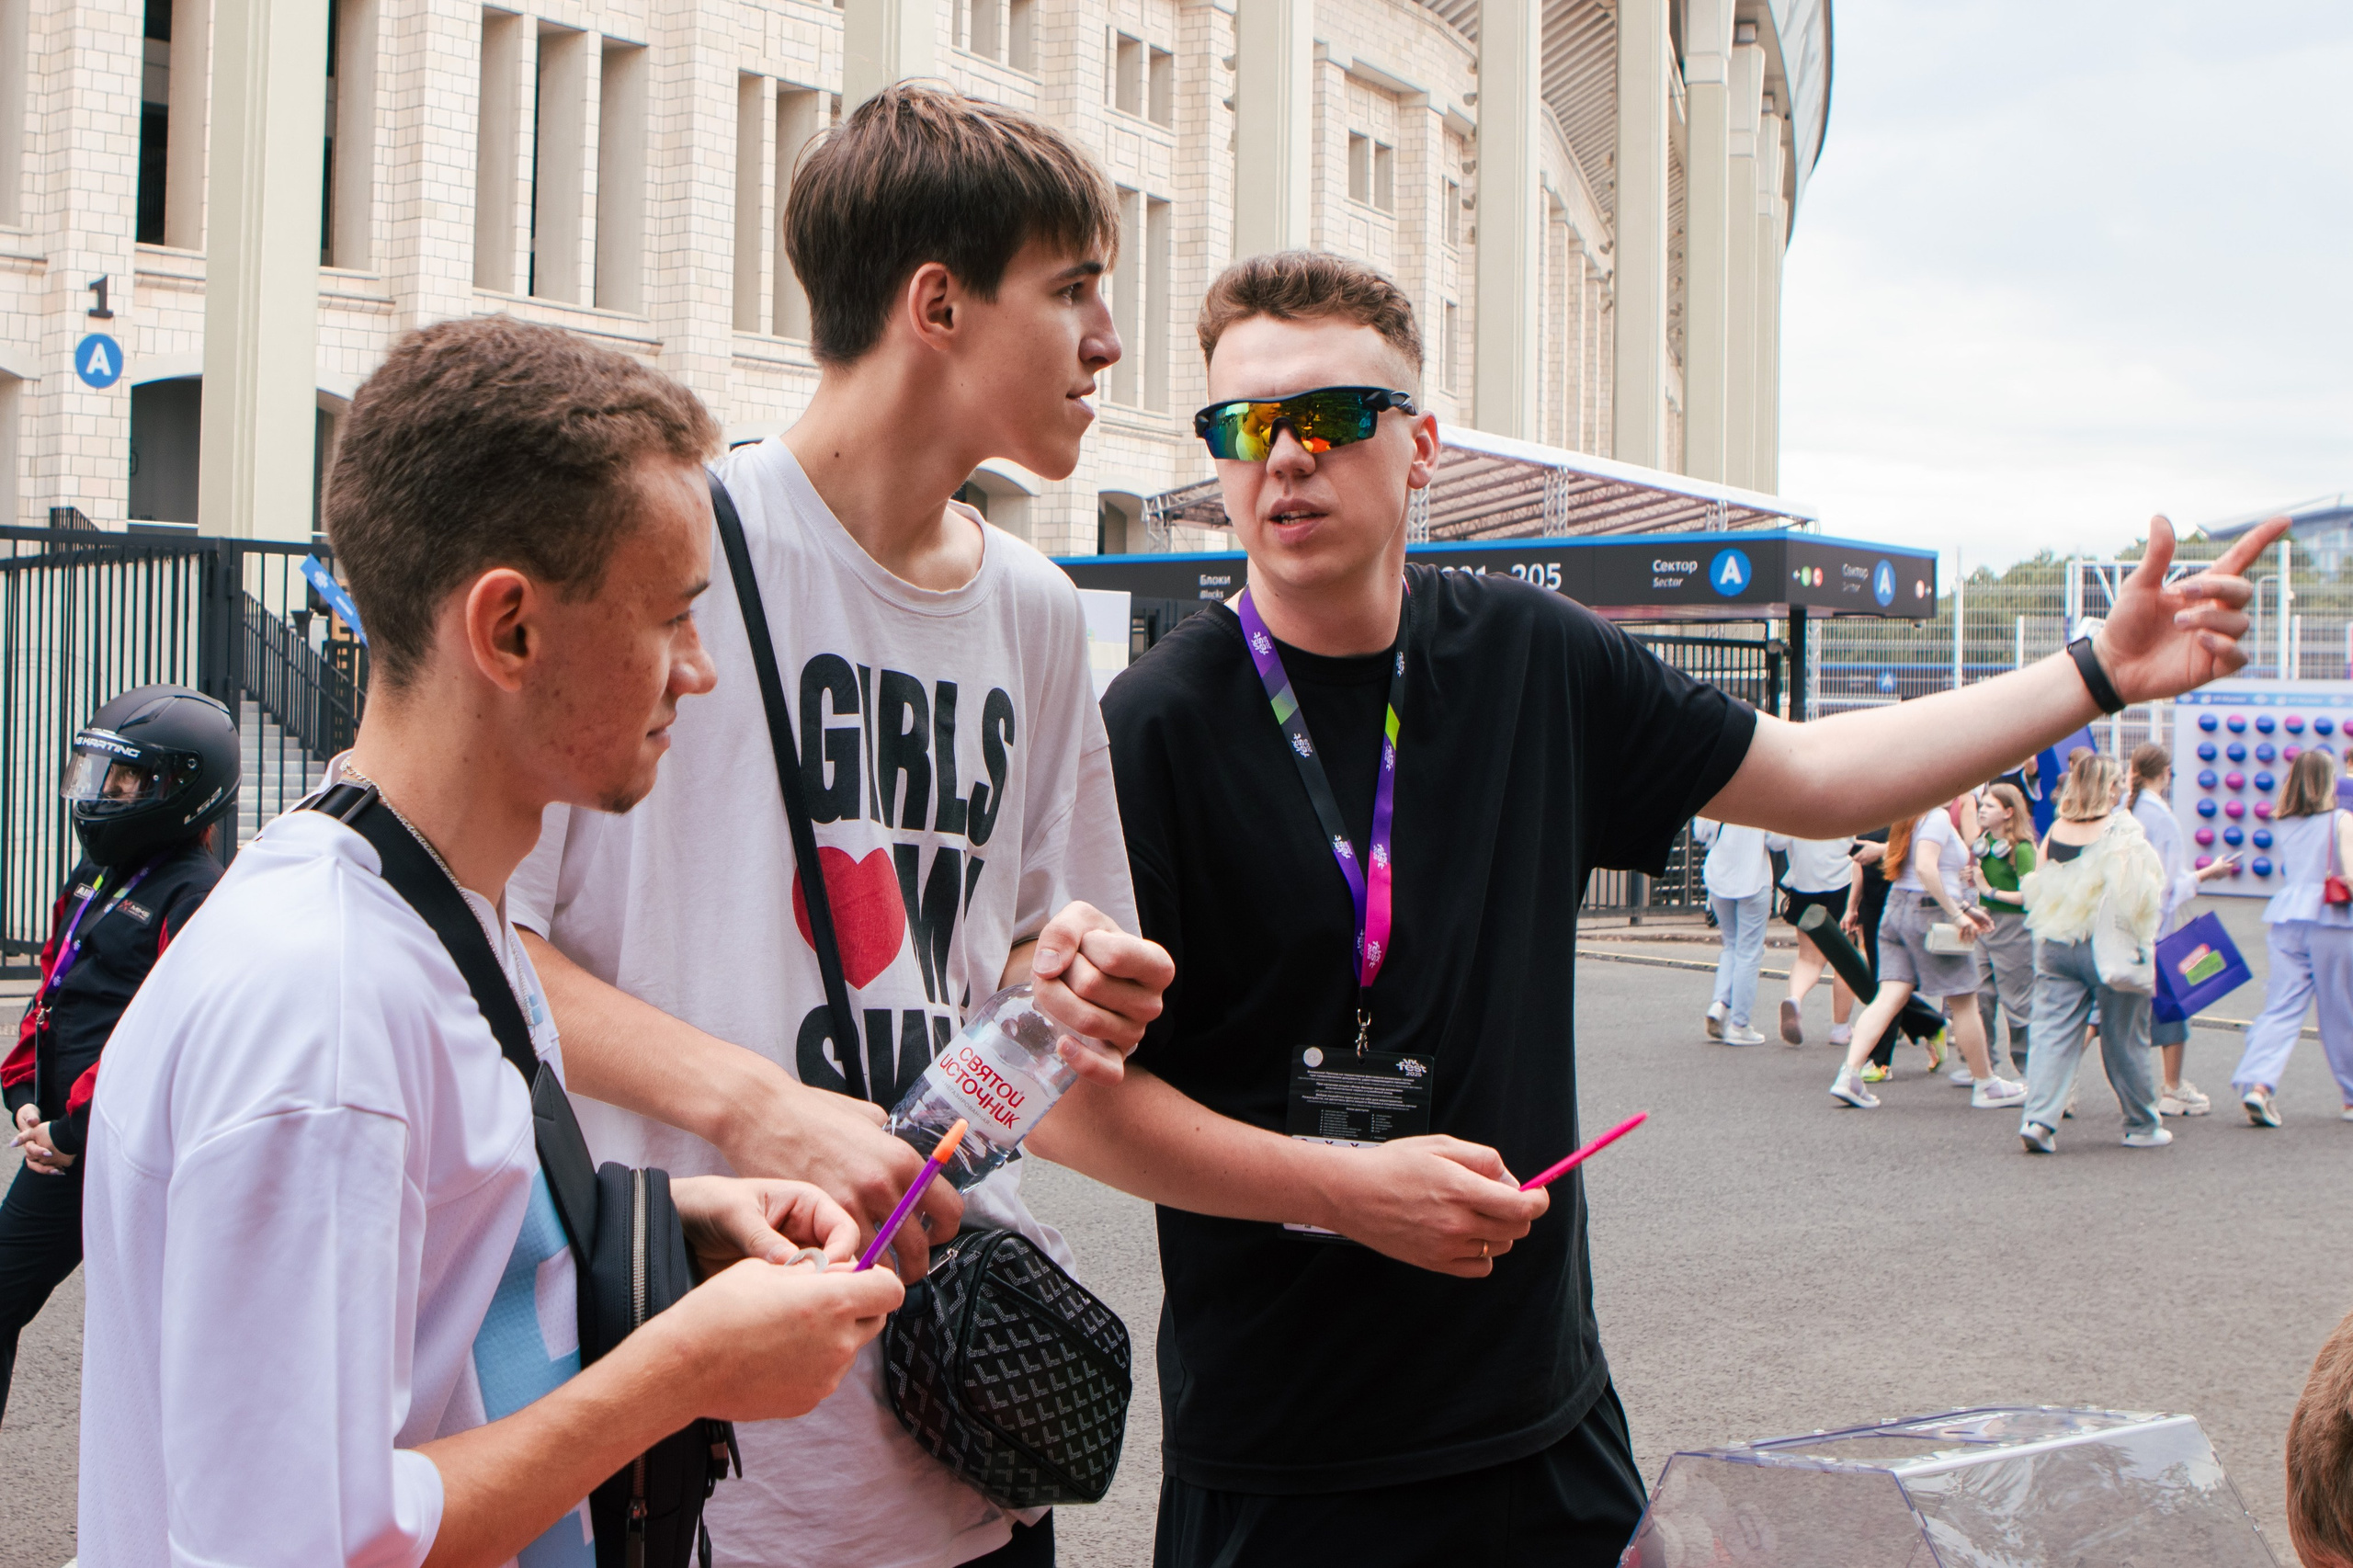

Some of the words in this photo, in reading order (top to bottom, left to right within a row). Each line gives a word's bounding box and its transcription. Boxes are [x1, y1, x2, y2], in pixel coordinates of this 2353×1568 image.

[88, 274, 115, 319] 1
[85, 342, 112, 376] A
[1199, 574, 1231, 586] Блоки
[1510, 562, 1563, 591] 205
[1652, 559, 1699, 574] Сектор
[1719, 555, 1743, 585] A
[1653, 576, 1684, 588] Sector
[799, 653, 1016, 847] GIRLS
[959, 1046, 1025, 1109] СВЯТОЙ
[1395, 1061, 1427, 1074] fest
[939, 1052, 1020, 1131] ИСТОЧНИК
